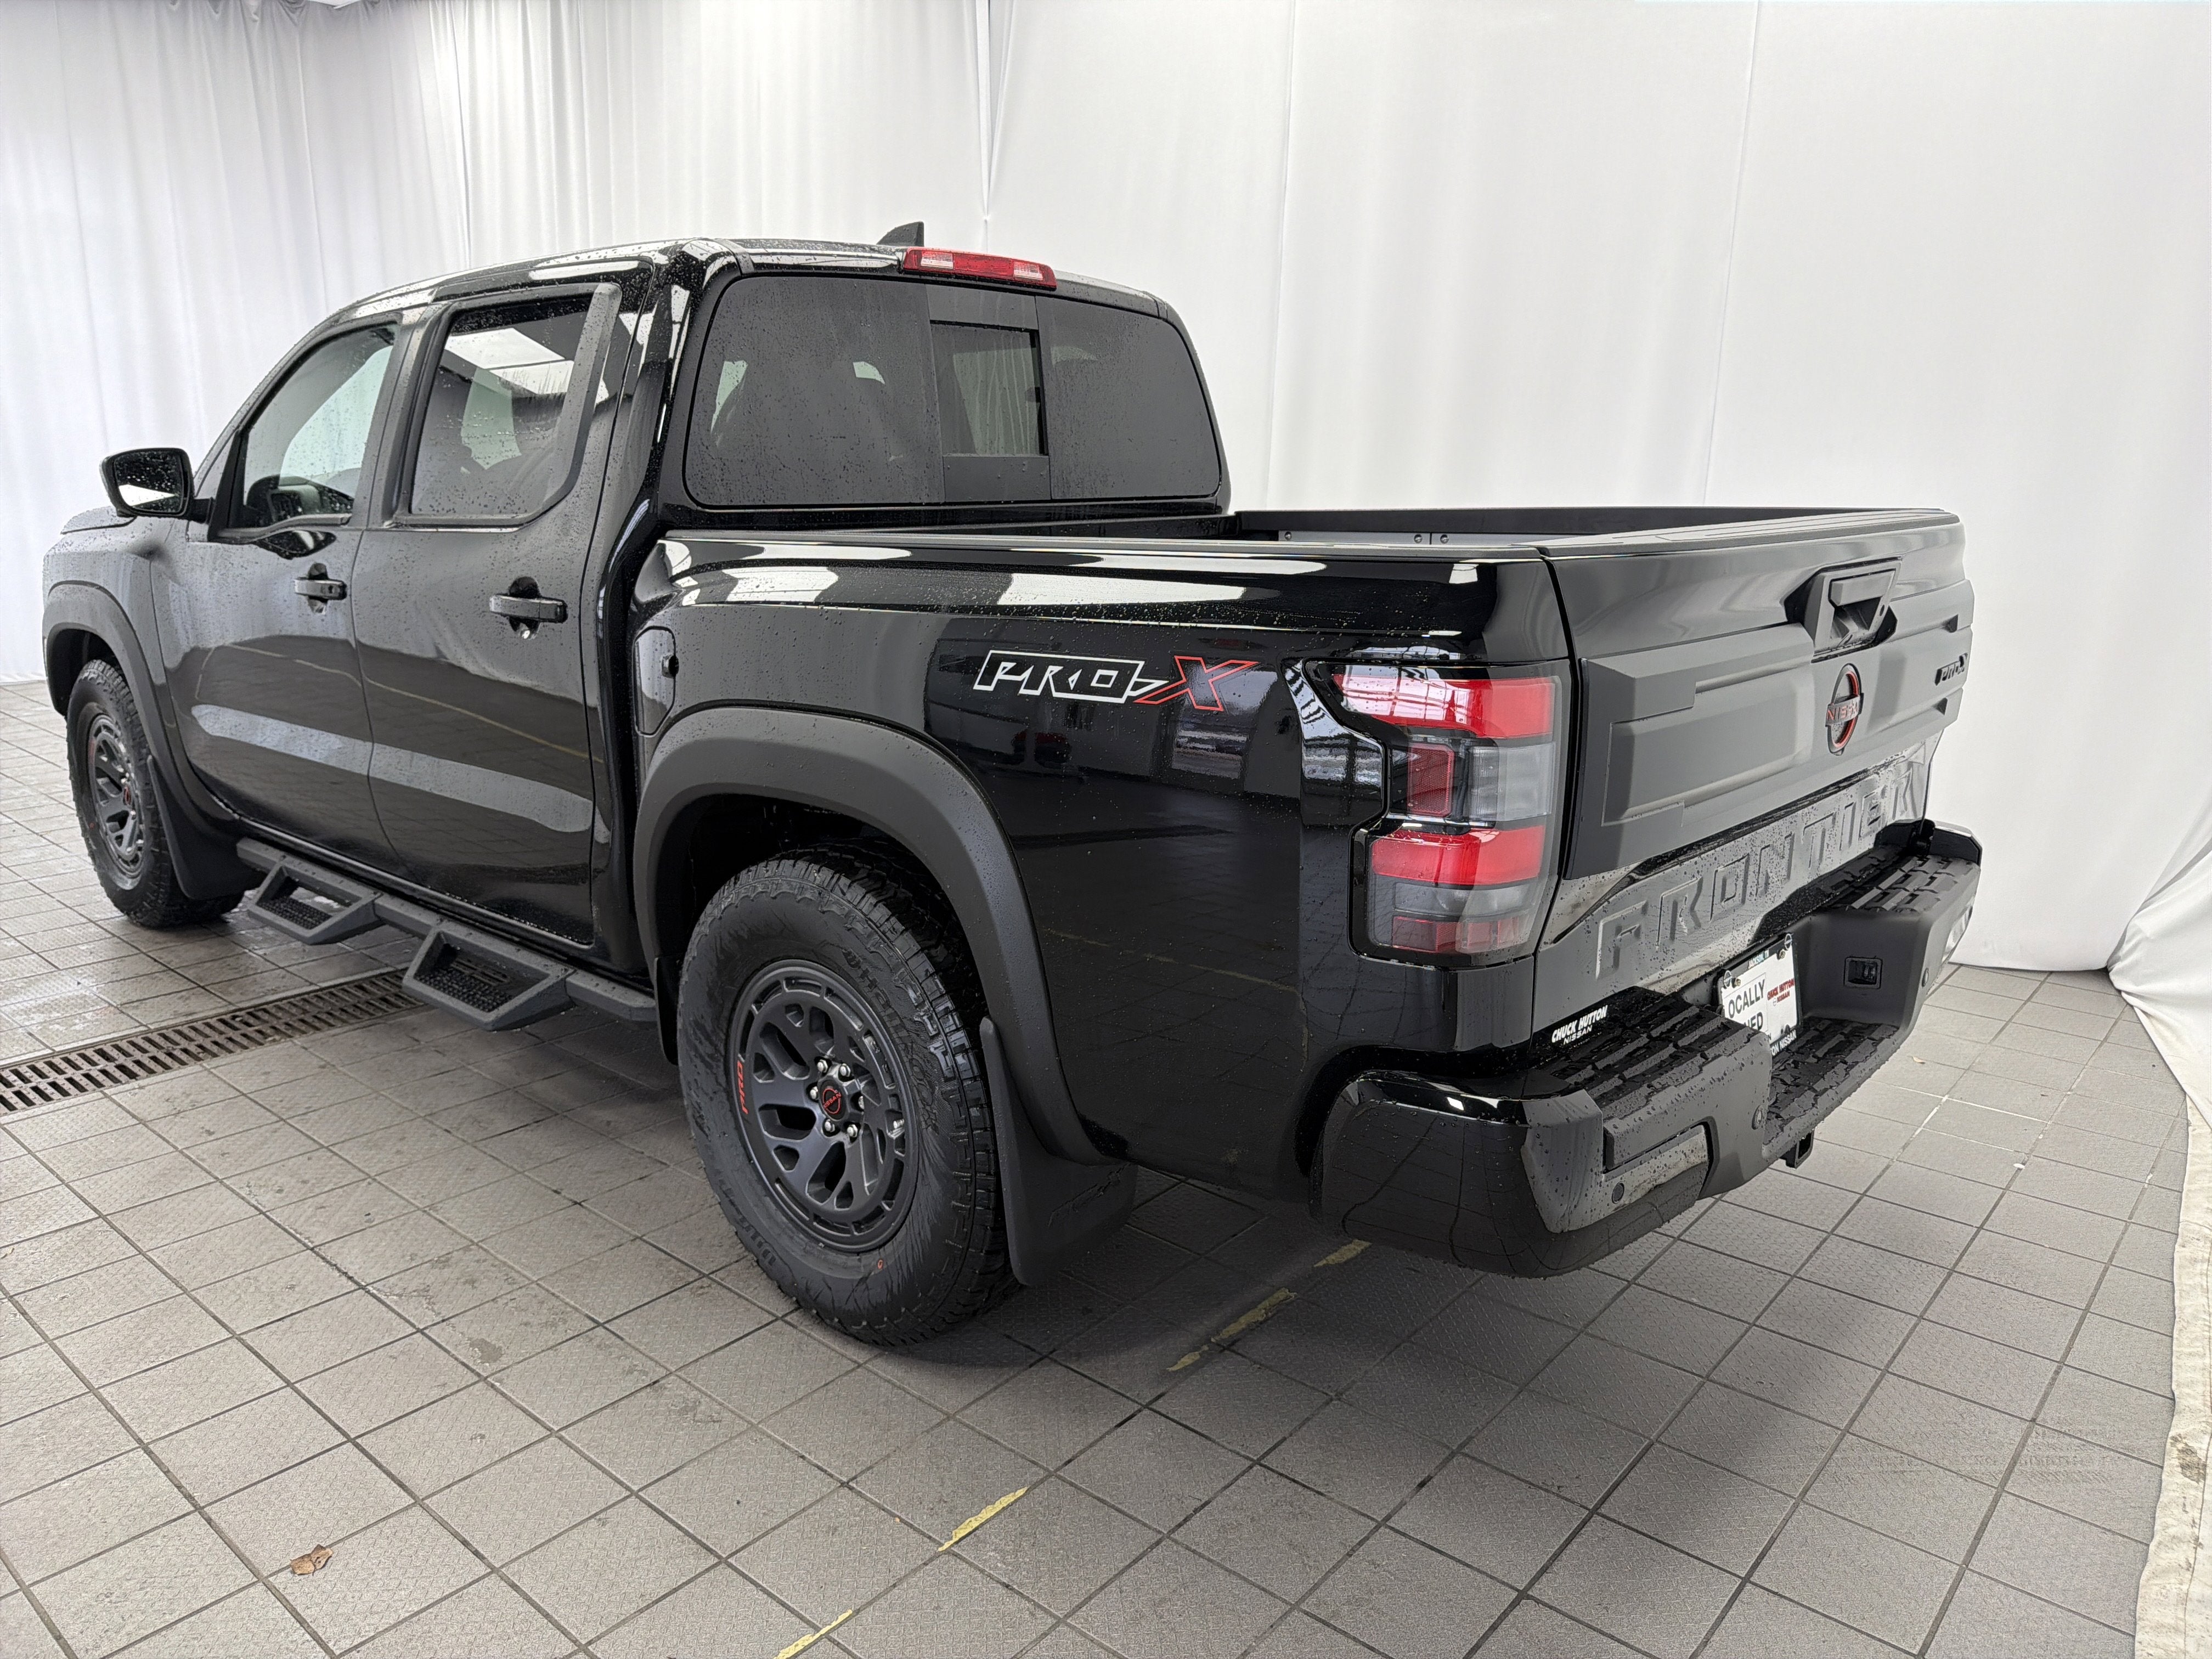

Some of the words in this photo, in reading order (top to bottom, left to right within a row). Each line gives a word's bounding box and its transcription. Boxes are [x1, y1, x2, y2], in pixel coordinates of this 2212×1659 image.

[1595, 761, 1918, 981] FRONTIER
[1728, 979, 1765, 1019] OCALLY
[1551, 1020, 1578, 1043] CHUCK
[1578, 1005, 1608, 1030] HUTTON
[1564, 1024, 1593, 1045] NISSAN
[1779, 1029, 1797, 1051] NISSAN
